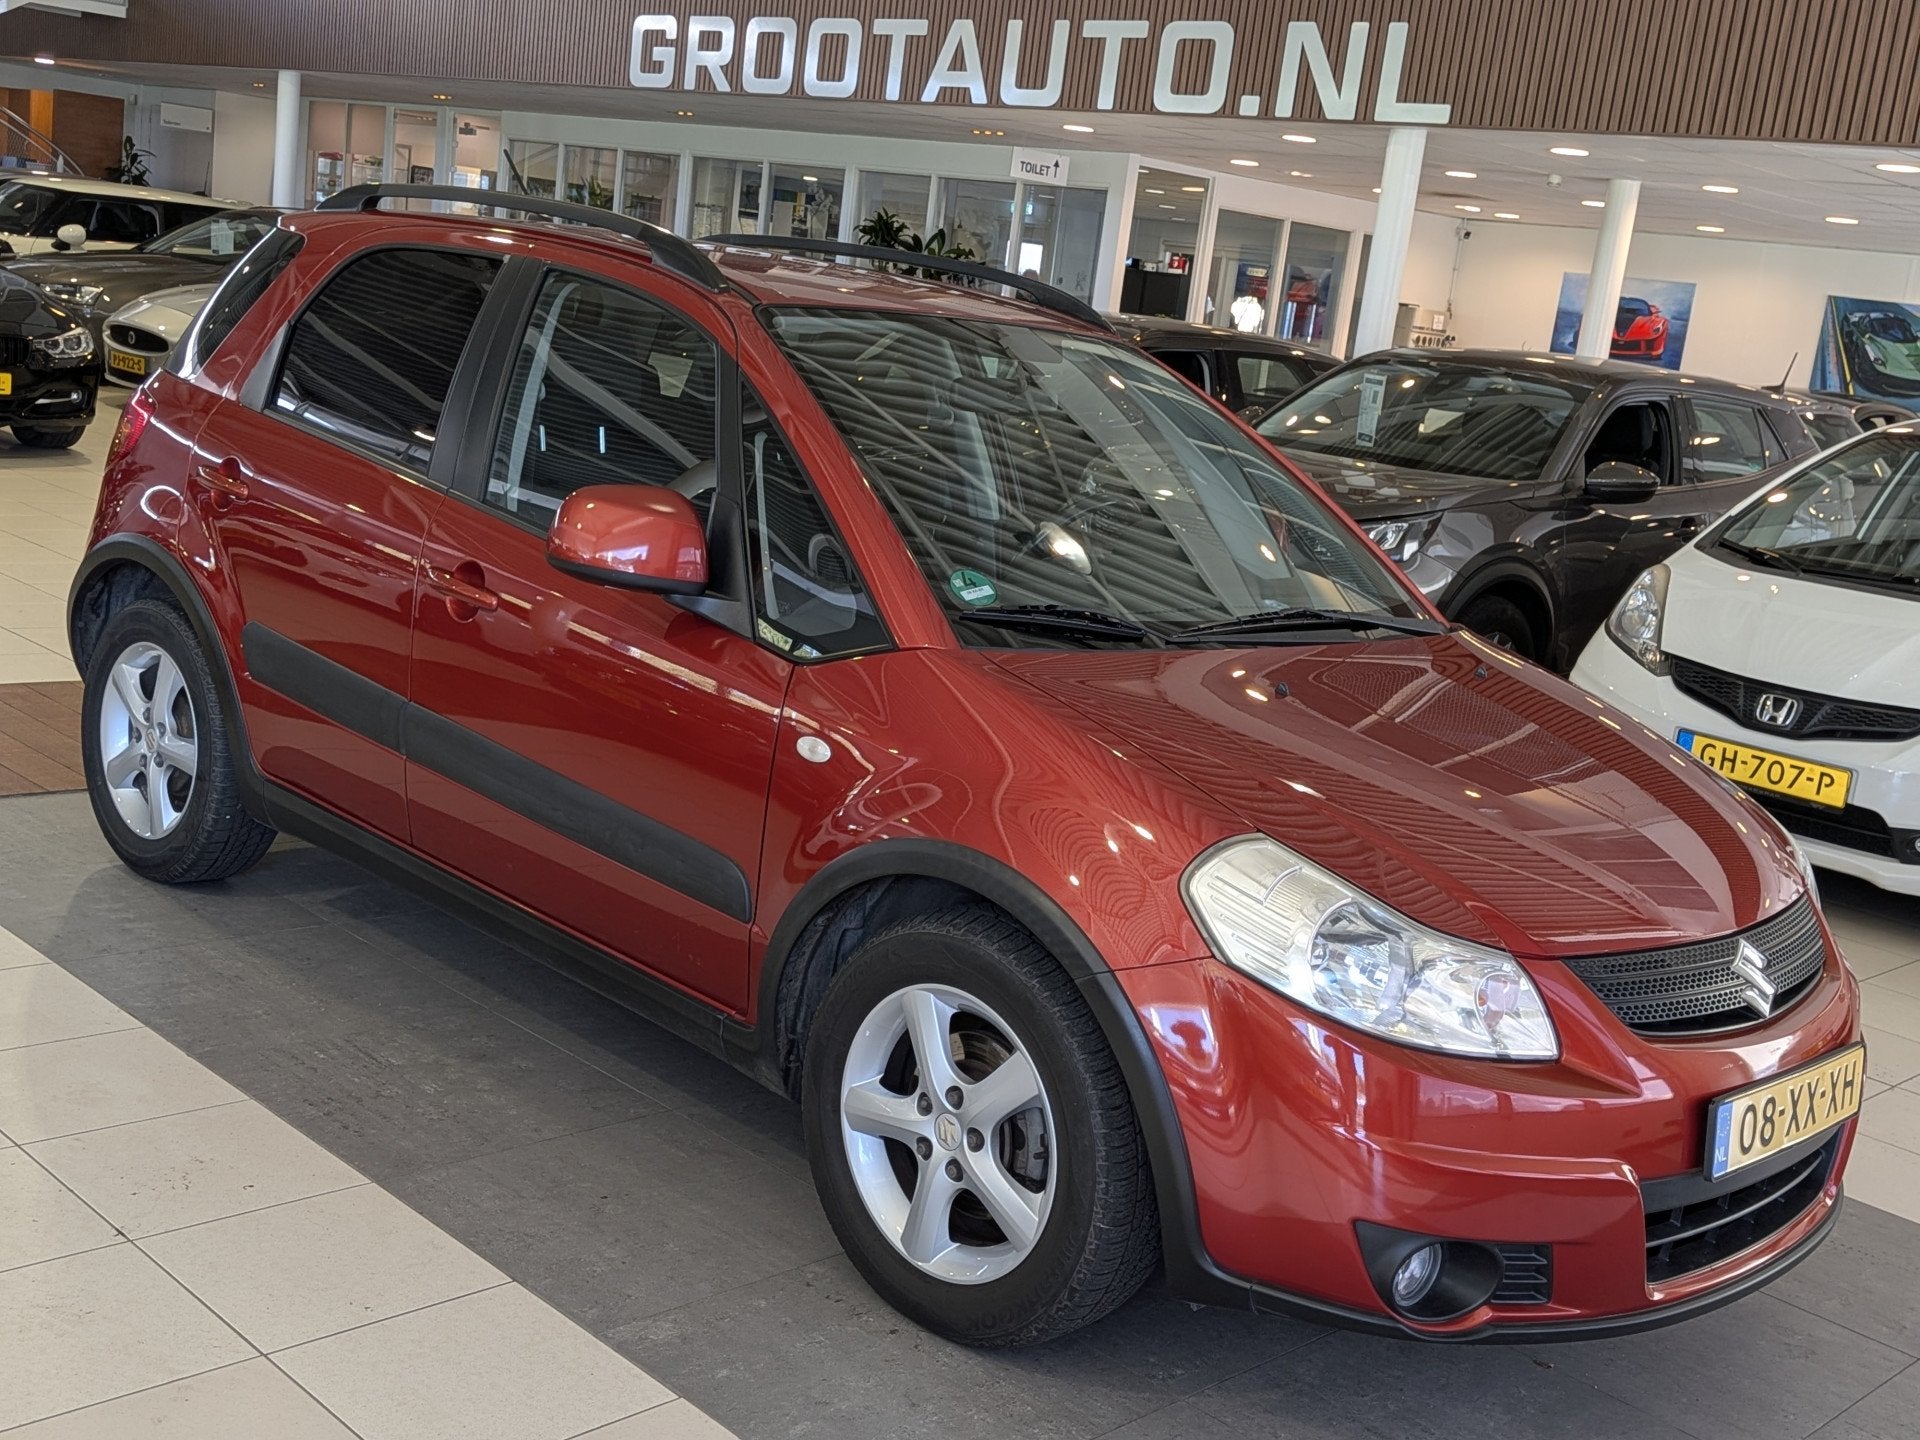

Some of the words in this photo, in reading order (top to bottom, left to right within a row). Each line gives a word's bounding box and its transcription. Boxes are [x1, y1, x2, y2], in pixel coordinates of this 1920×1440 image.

[629, 15, 1452, 124] GROOTAUTO.NL
[1020, 161, 1051, 177] TOILET
[961, 571, 977, 588] 4
[1700, 743, 1835, 796] GH-707-P
[1740, 1059, 1857, 1156] 08-XX-XH
[1715, 1147, 1727, 1164] NL
